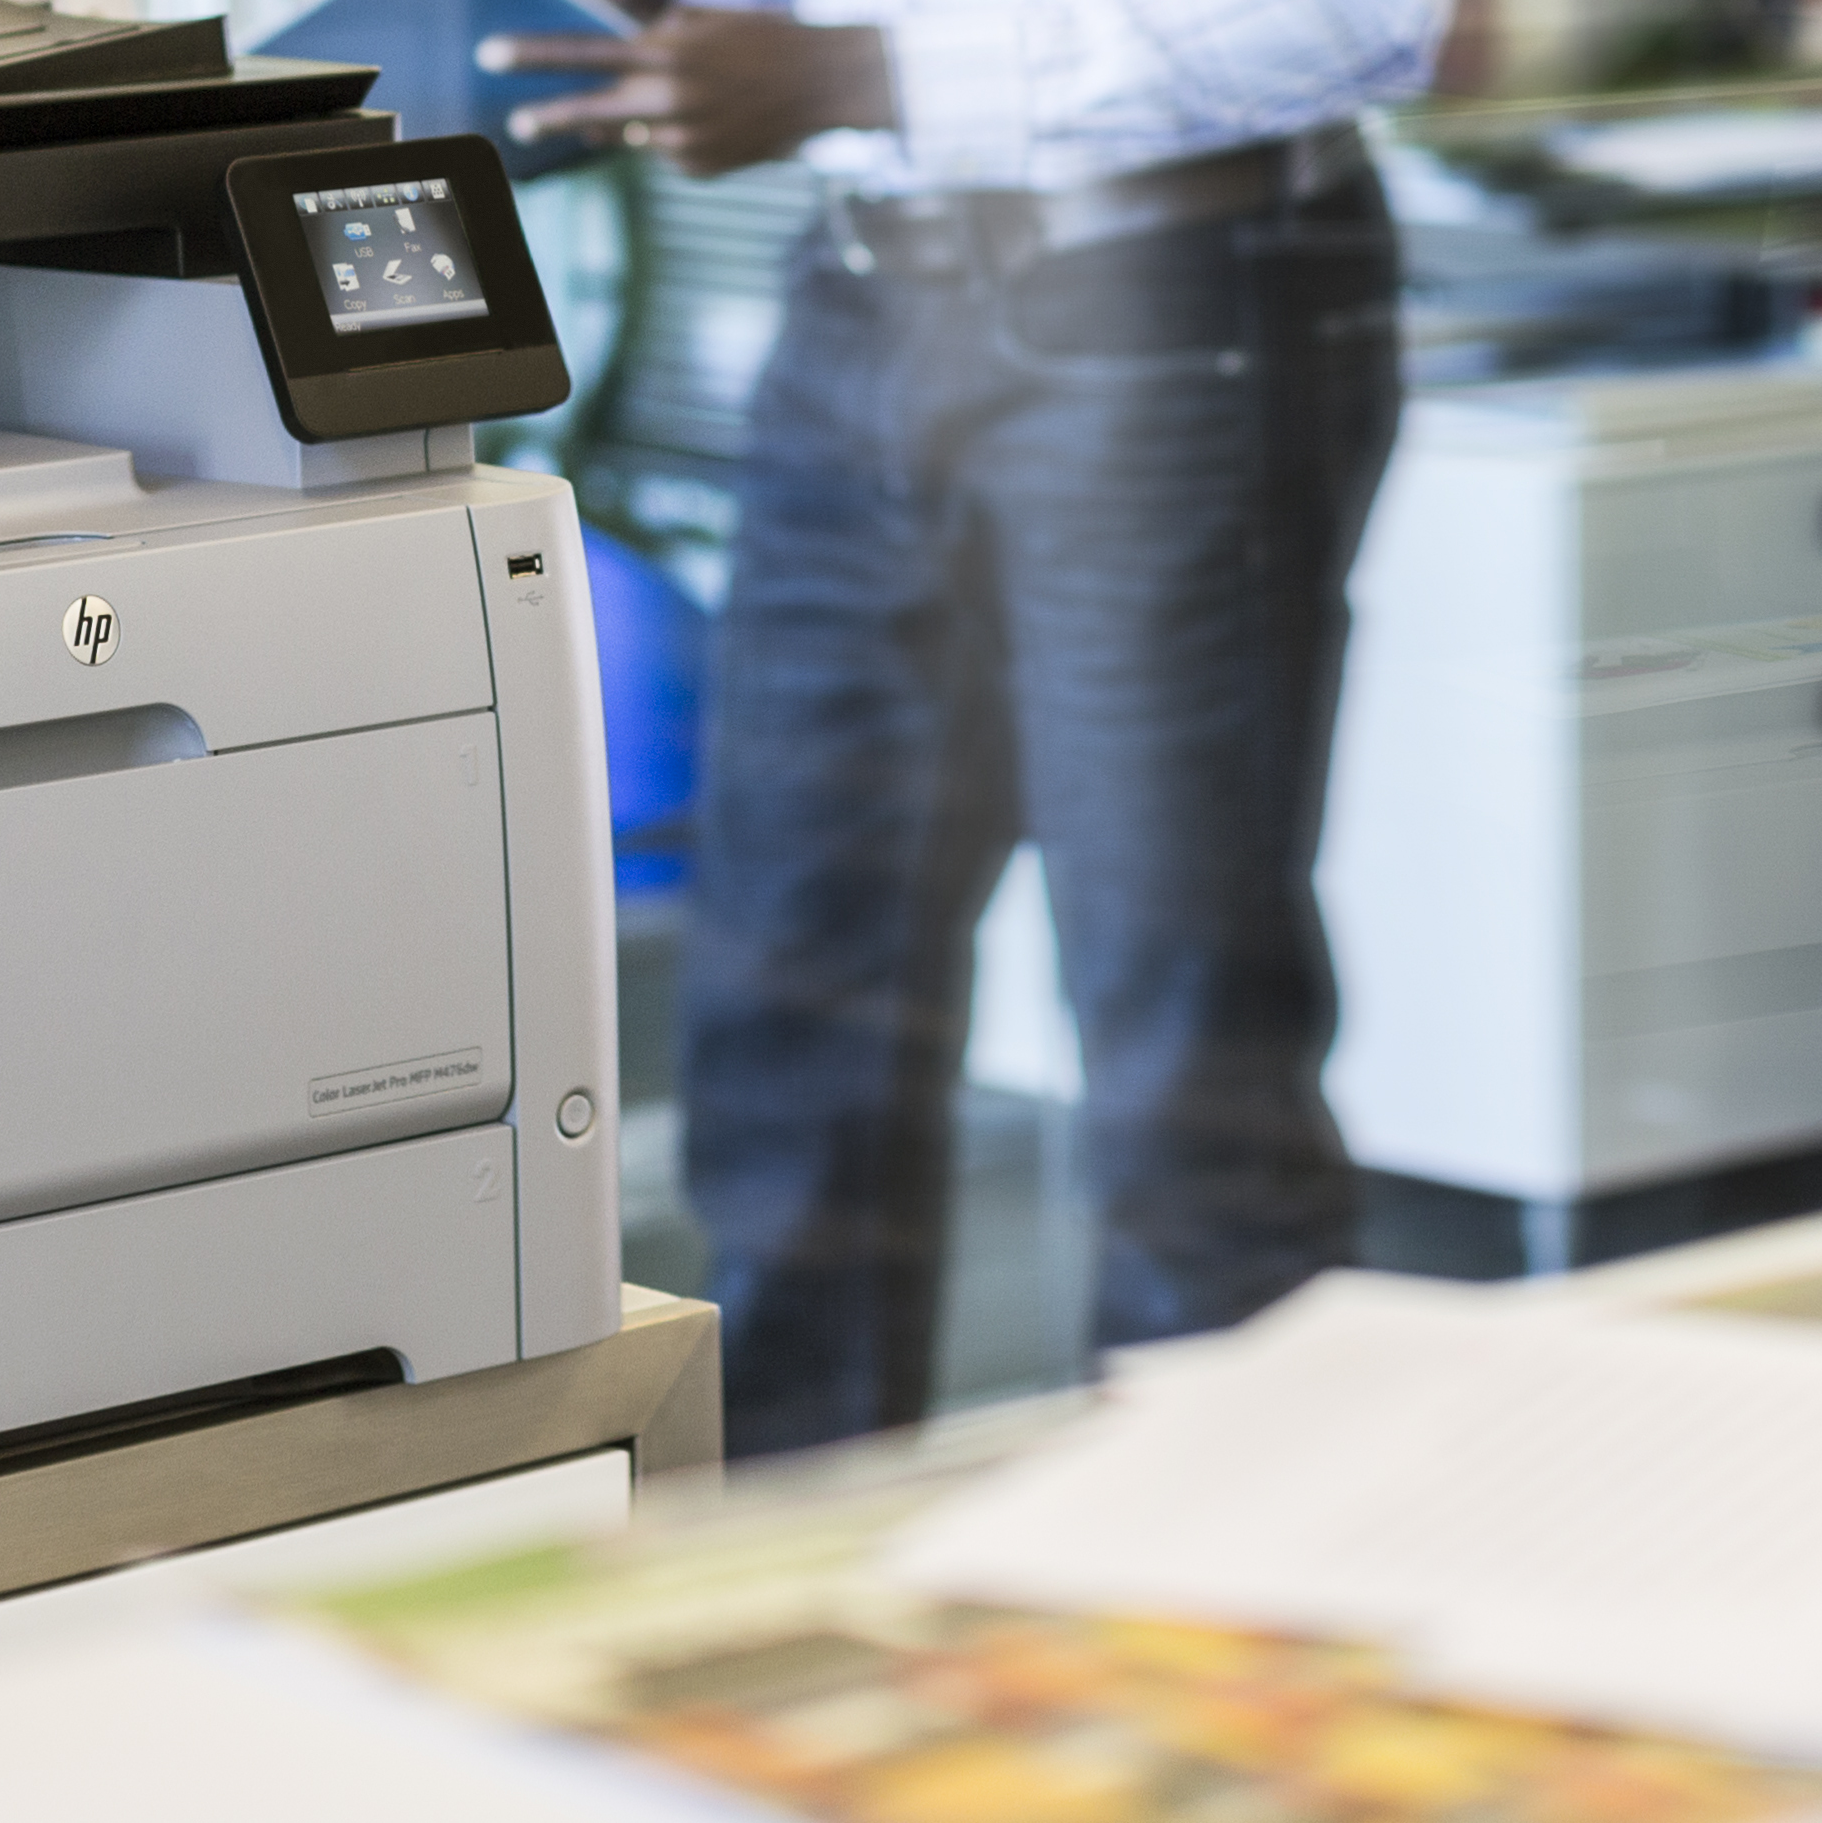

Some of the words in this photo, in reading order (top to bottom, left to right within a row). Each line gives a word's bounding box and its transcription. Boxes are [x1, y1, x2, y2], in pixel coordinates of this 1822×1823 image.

[354, 247, 374, 258] USB
[404, 242, 422, 253] Fax
[344, 299, 367, 311] Copy
[393, 294, 416, 305] Scan
[443, 289, 464, 301] Apps
[334, 321, 362, 333] Ready
[74, 596, 112, 665] hp
[312, 1088, 340, 1104] Color
[342, 1078, 387, 1098] LaserJet
[389, 1075, 407, 1088] Pro
[409, 1069, 431, 1085] MFP
